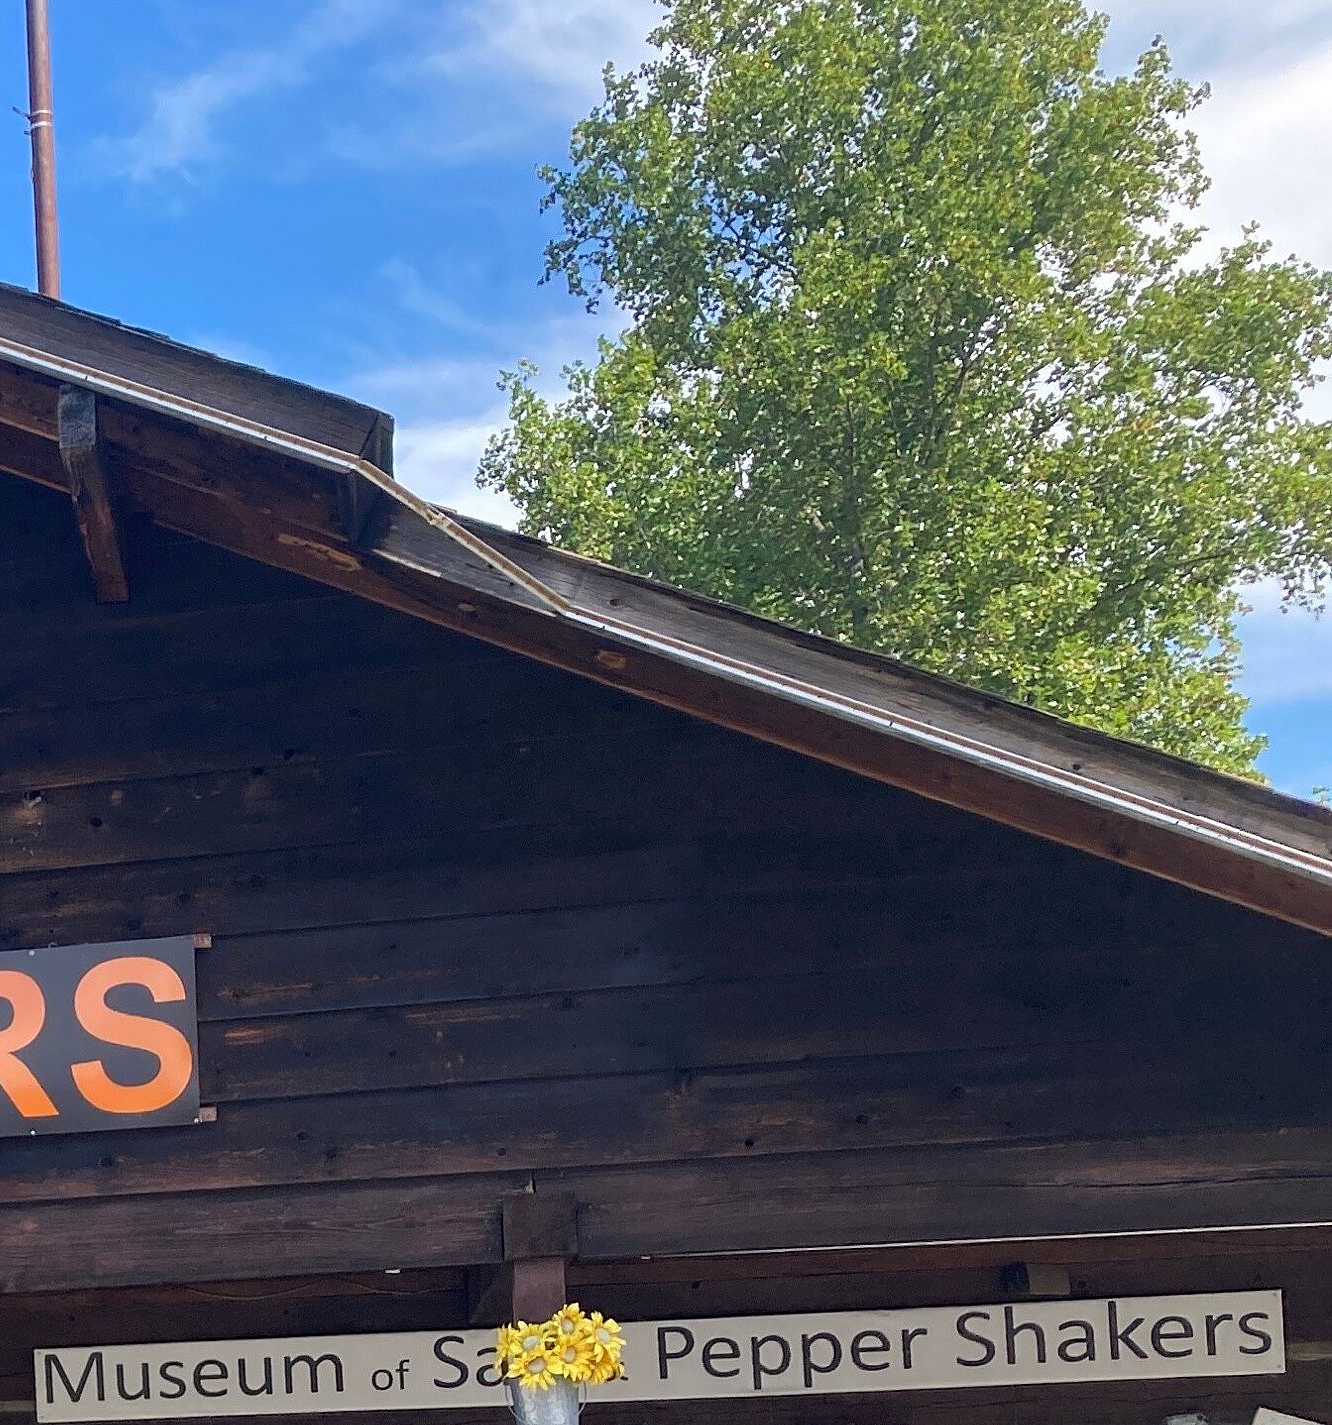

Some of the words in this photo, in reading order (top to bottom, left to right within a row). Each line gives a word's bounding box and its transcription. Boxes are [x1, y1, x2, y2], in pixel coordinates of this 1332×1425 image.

[43, 1350, 345, 1405] Museum
[371, 1359, 411, 1392] of
[656, 1325, 929, 1391] Pepper
[955, 1300, 1273, 1369] Shakers
